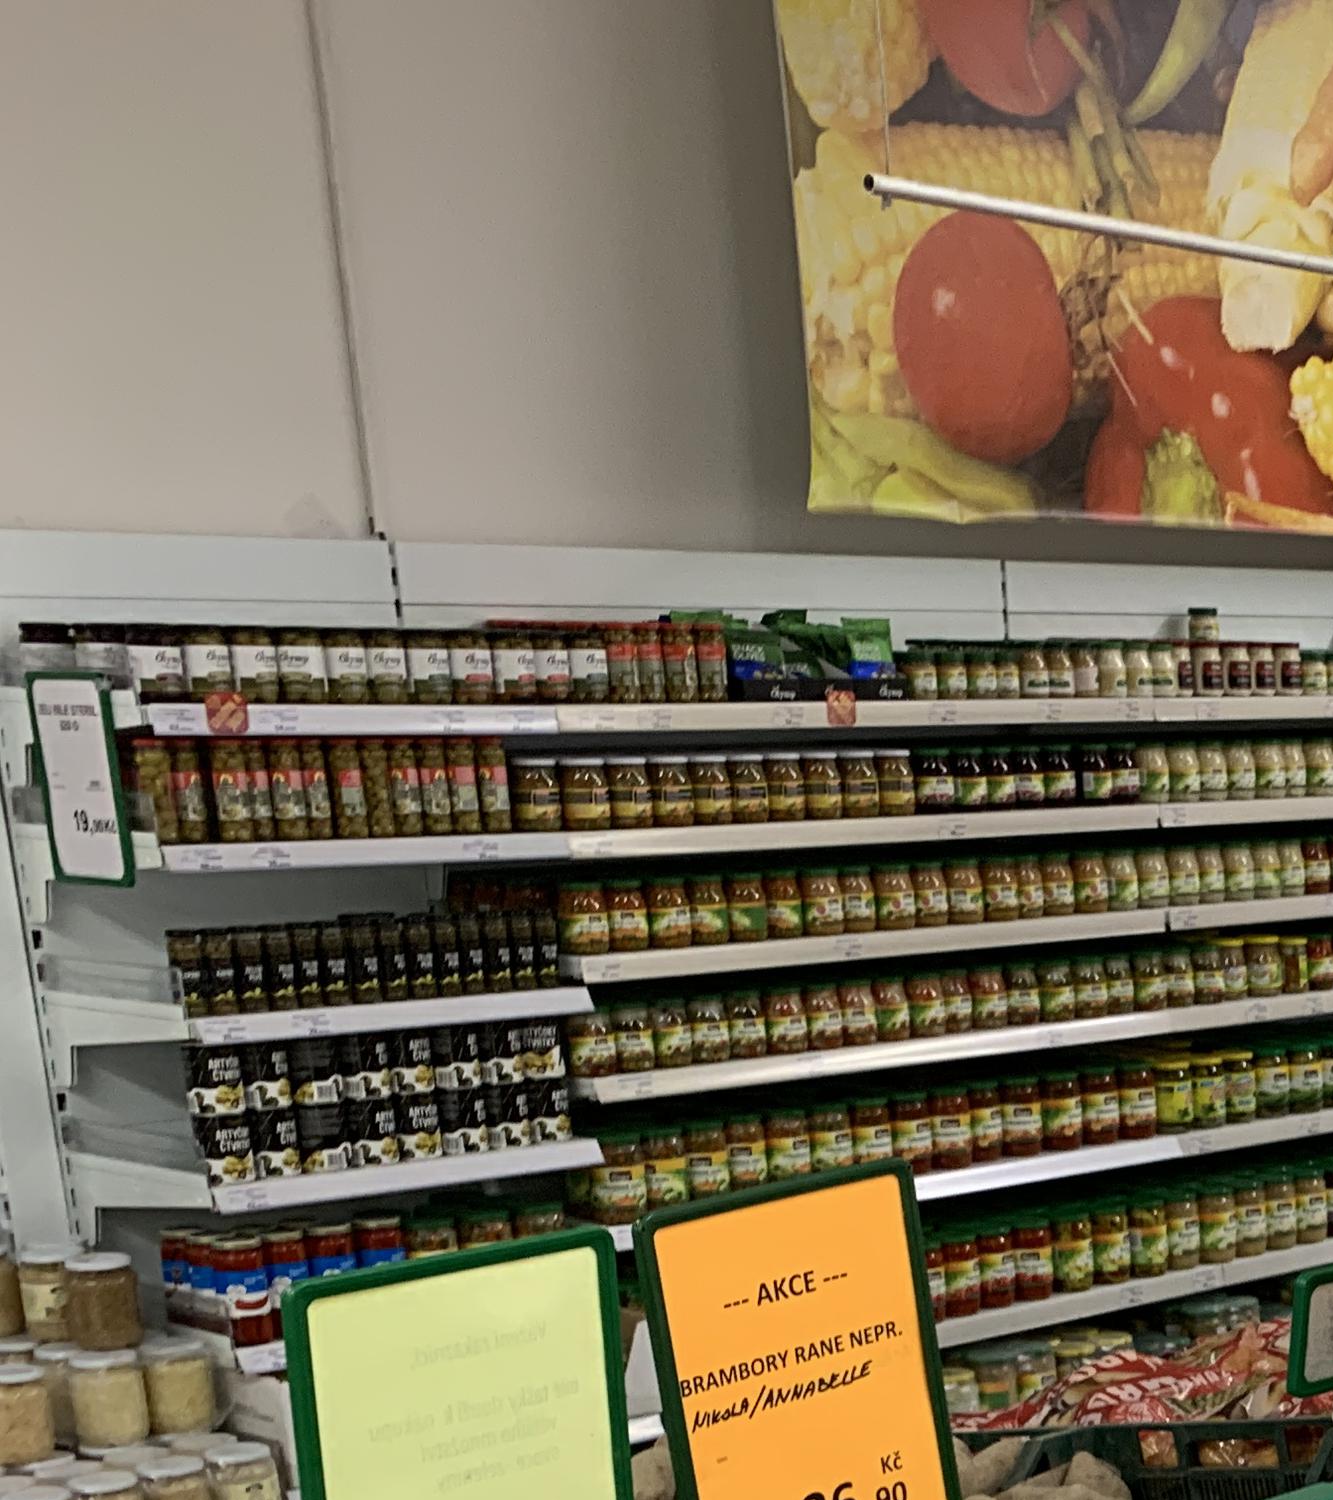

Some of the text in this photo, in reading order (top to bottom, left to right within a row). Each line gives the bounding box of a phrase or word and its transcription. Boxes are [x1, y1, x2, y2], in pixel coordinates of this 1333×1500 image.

[756, 1269, 817, 1307] AKCE
[679, 1320, 904, 1398] BRAMBORY RANE NEPR.
[880, 1450, 904, 1475] Kč
